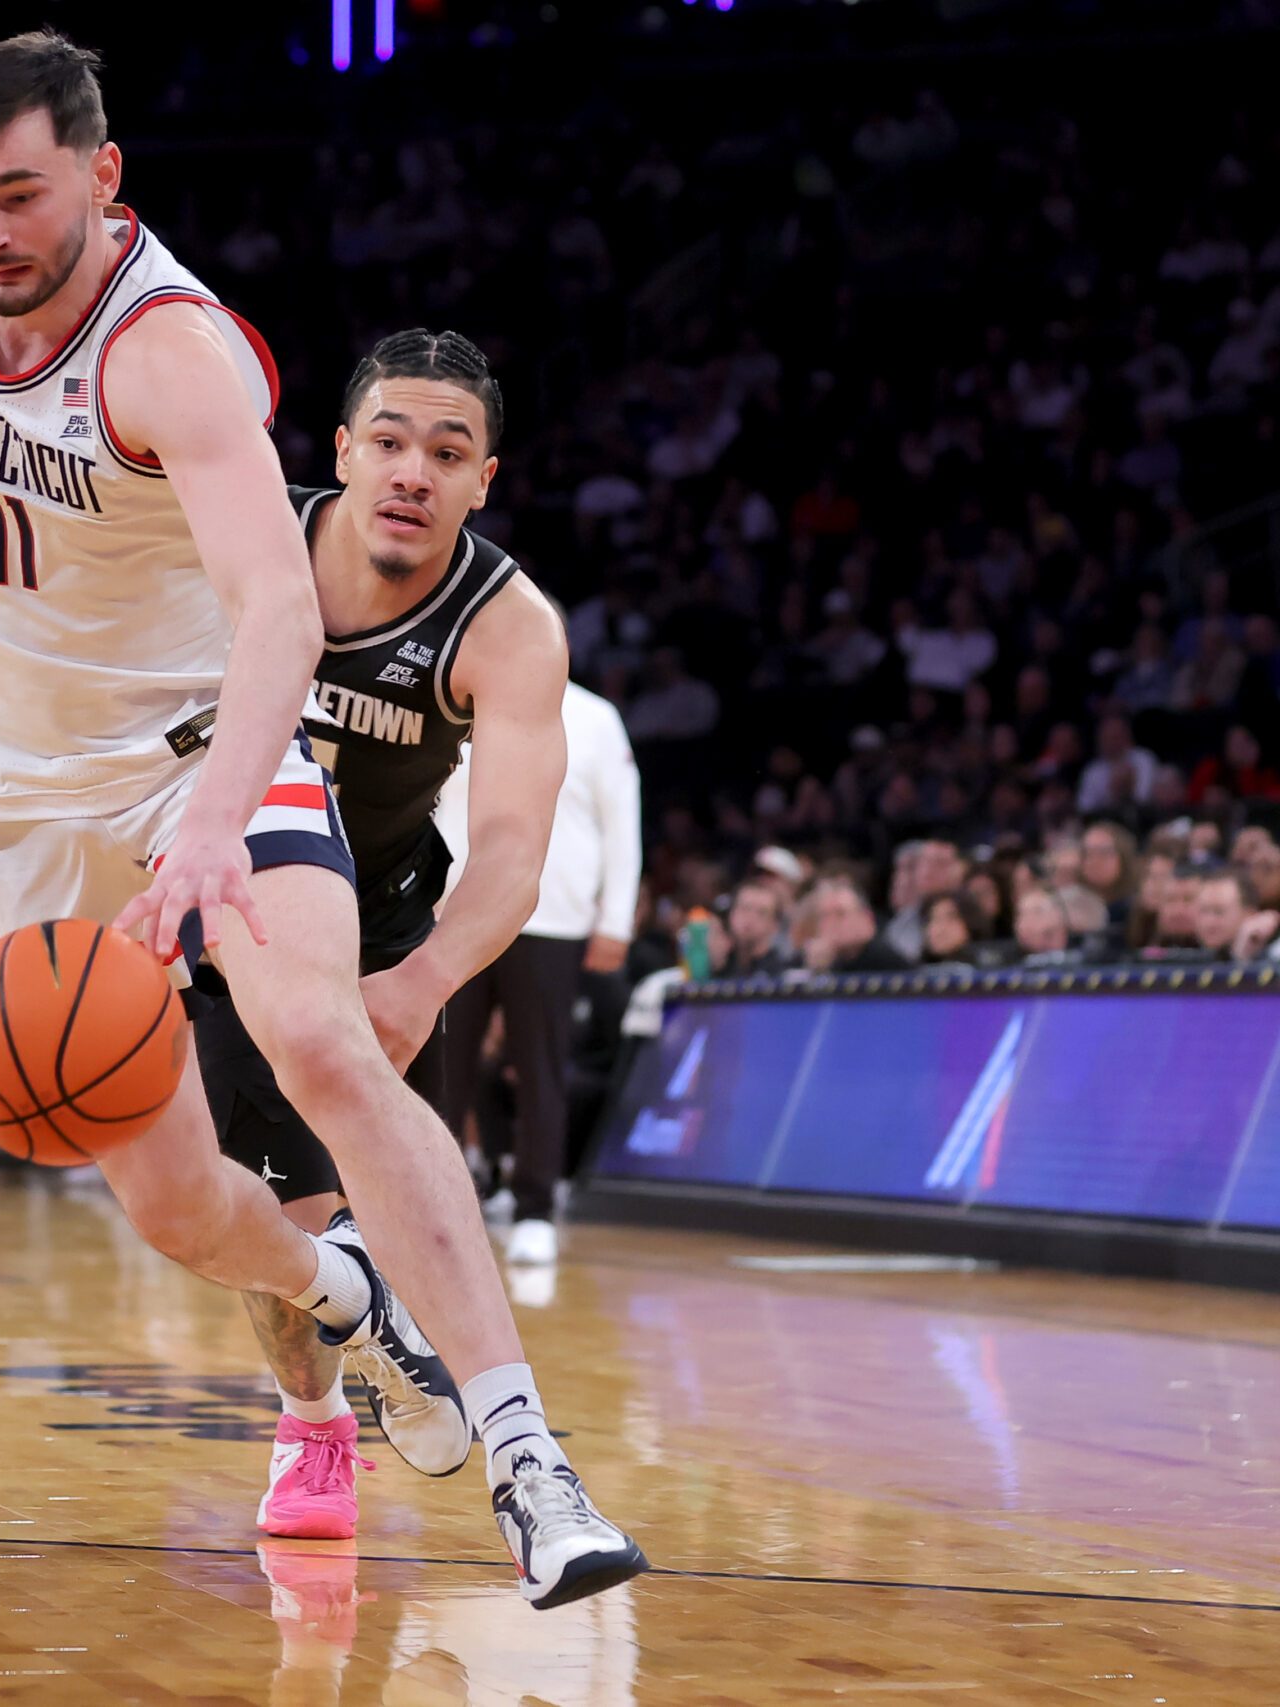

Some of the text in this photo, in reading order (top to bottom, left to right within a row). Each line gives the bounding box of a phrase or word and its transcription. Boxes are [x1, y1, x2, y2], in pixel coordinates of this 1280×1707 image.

[68, 415, 89, 425] BIG
[63, 425, 92, 435] EAST
[396, 647, 433, 668] CHANGE
[403, 640, 436, 659] BE THE
[379, 669, 420, 685] EAST
[385, 662, 415, 676] BIG
[310, 679, 424, 745] ETOWN
